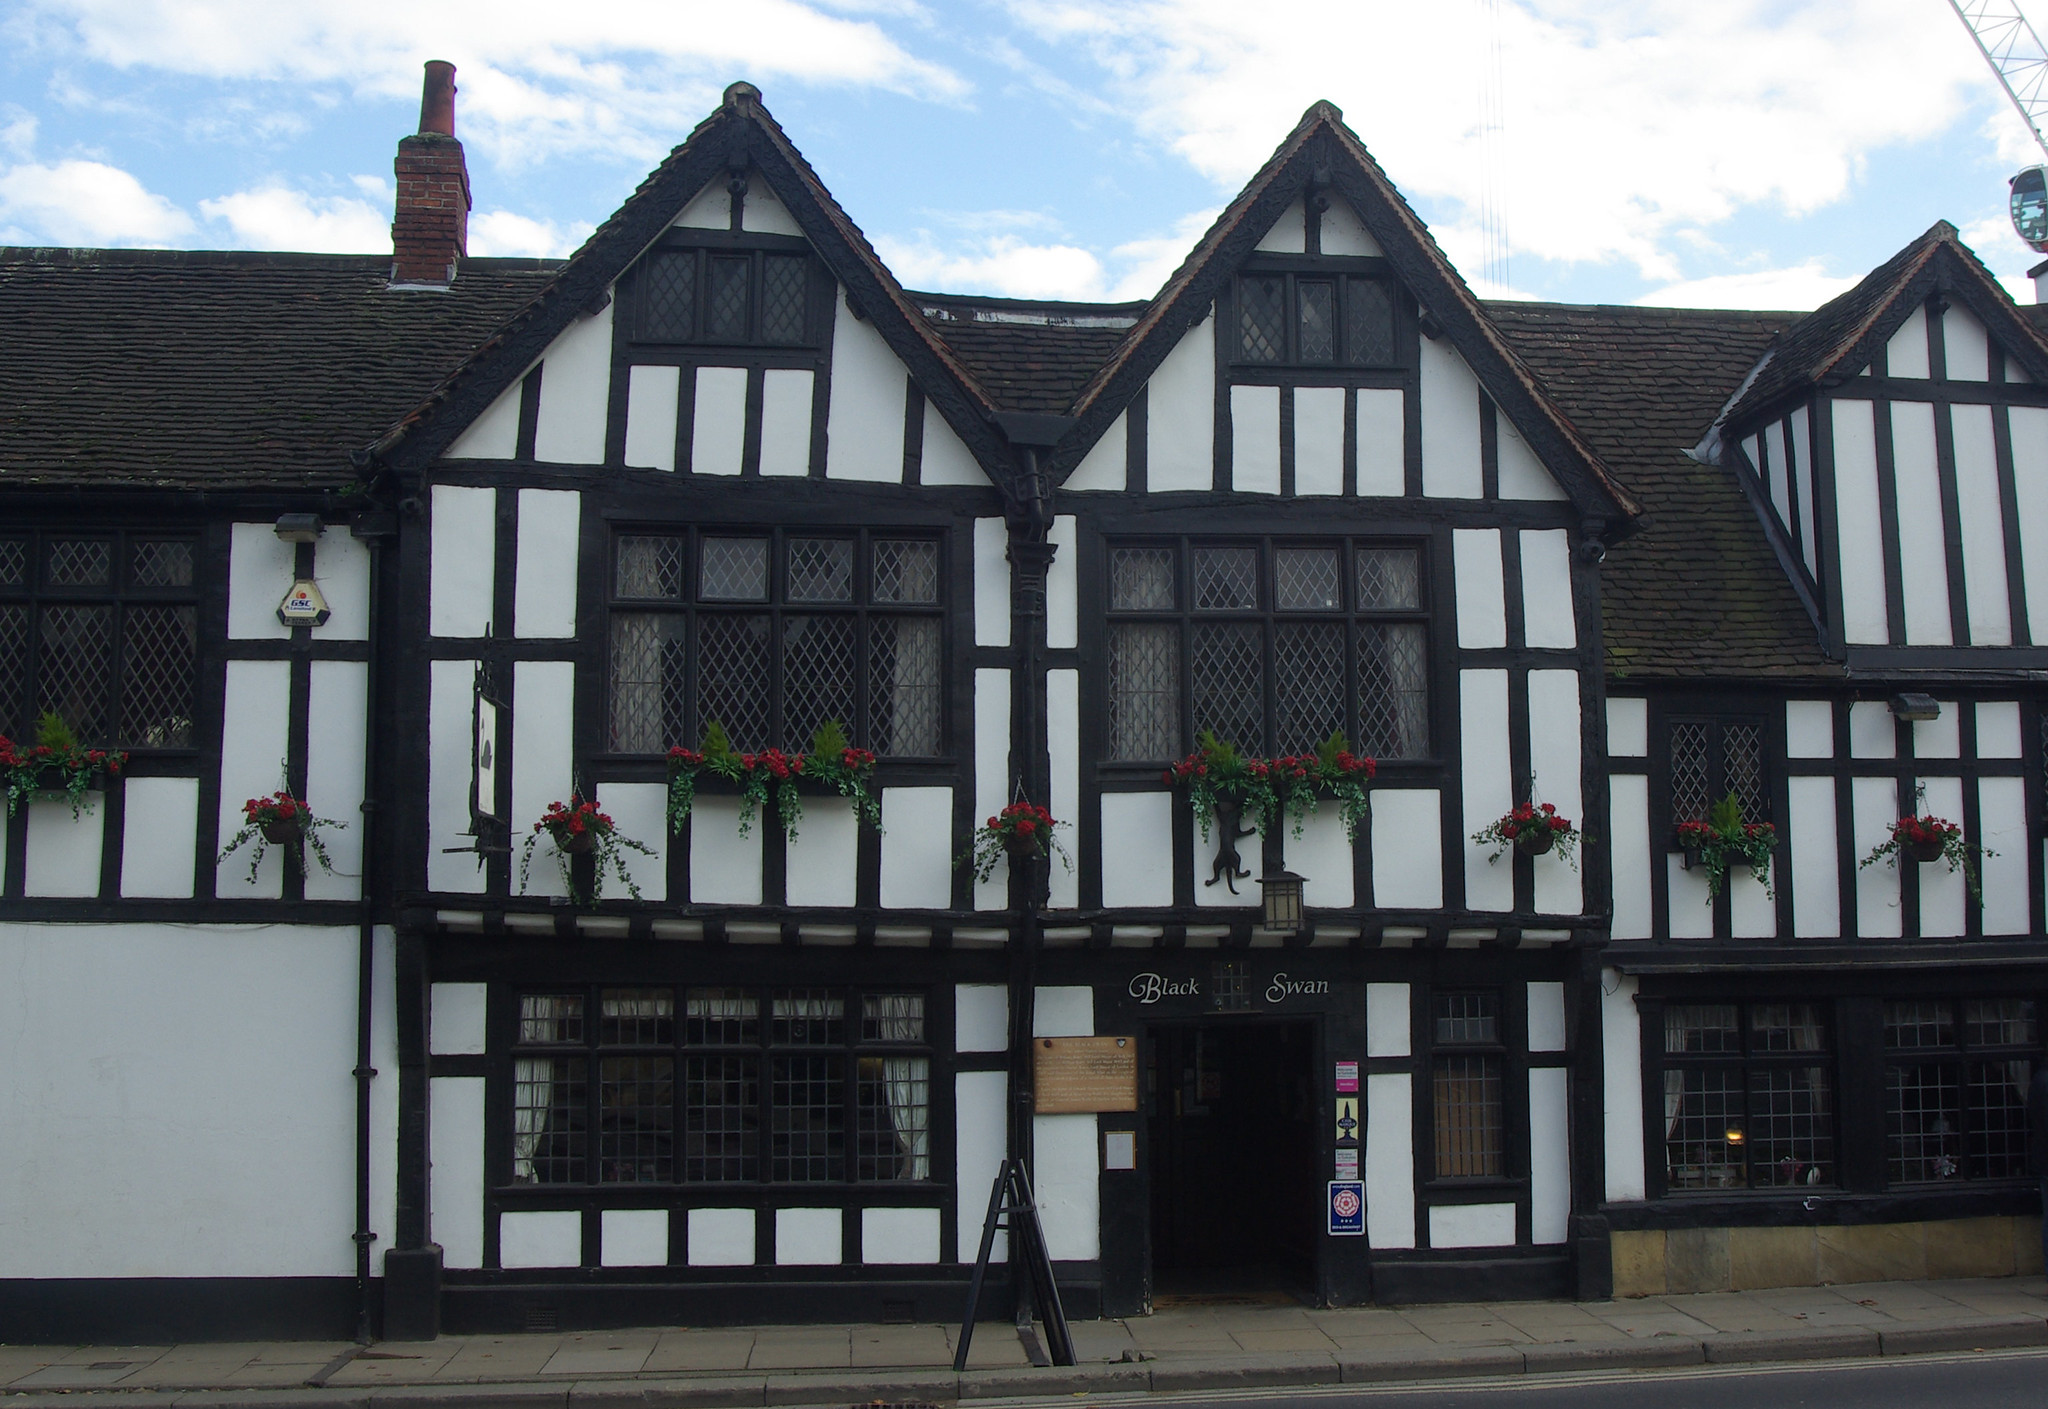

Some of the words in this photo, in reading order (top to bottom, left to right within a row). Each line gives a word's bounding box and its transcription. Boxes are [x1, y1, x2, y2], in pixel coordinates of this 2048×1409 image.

[291, 599, 311, 607] GSC
[1128, 972, 1199, 1004] Black
[1265, 972, 1329, 1003] Swan
